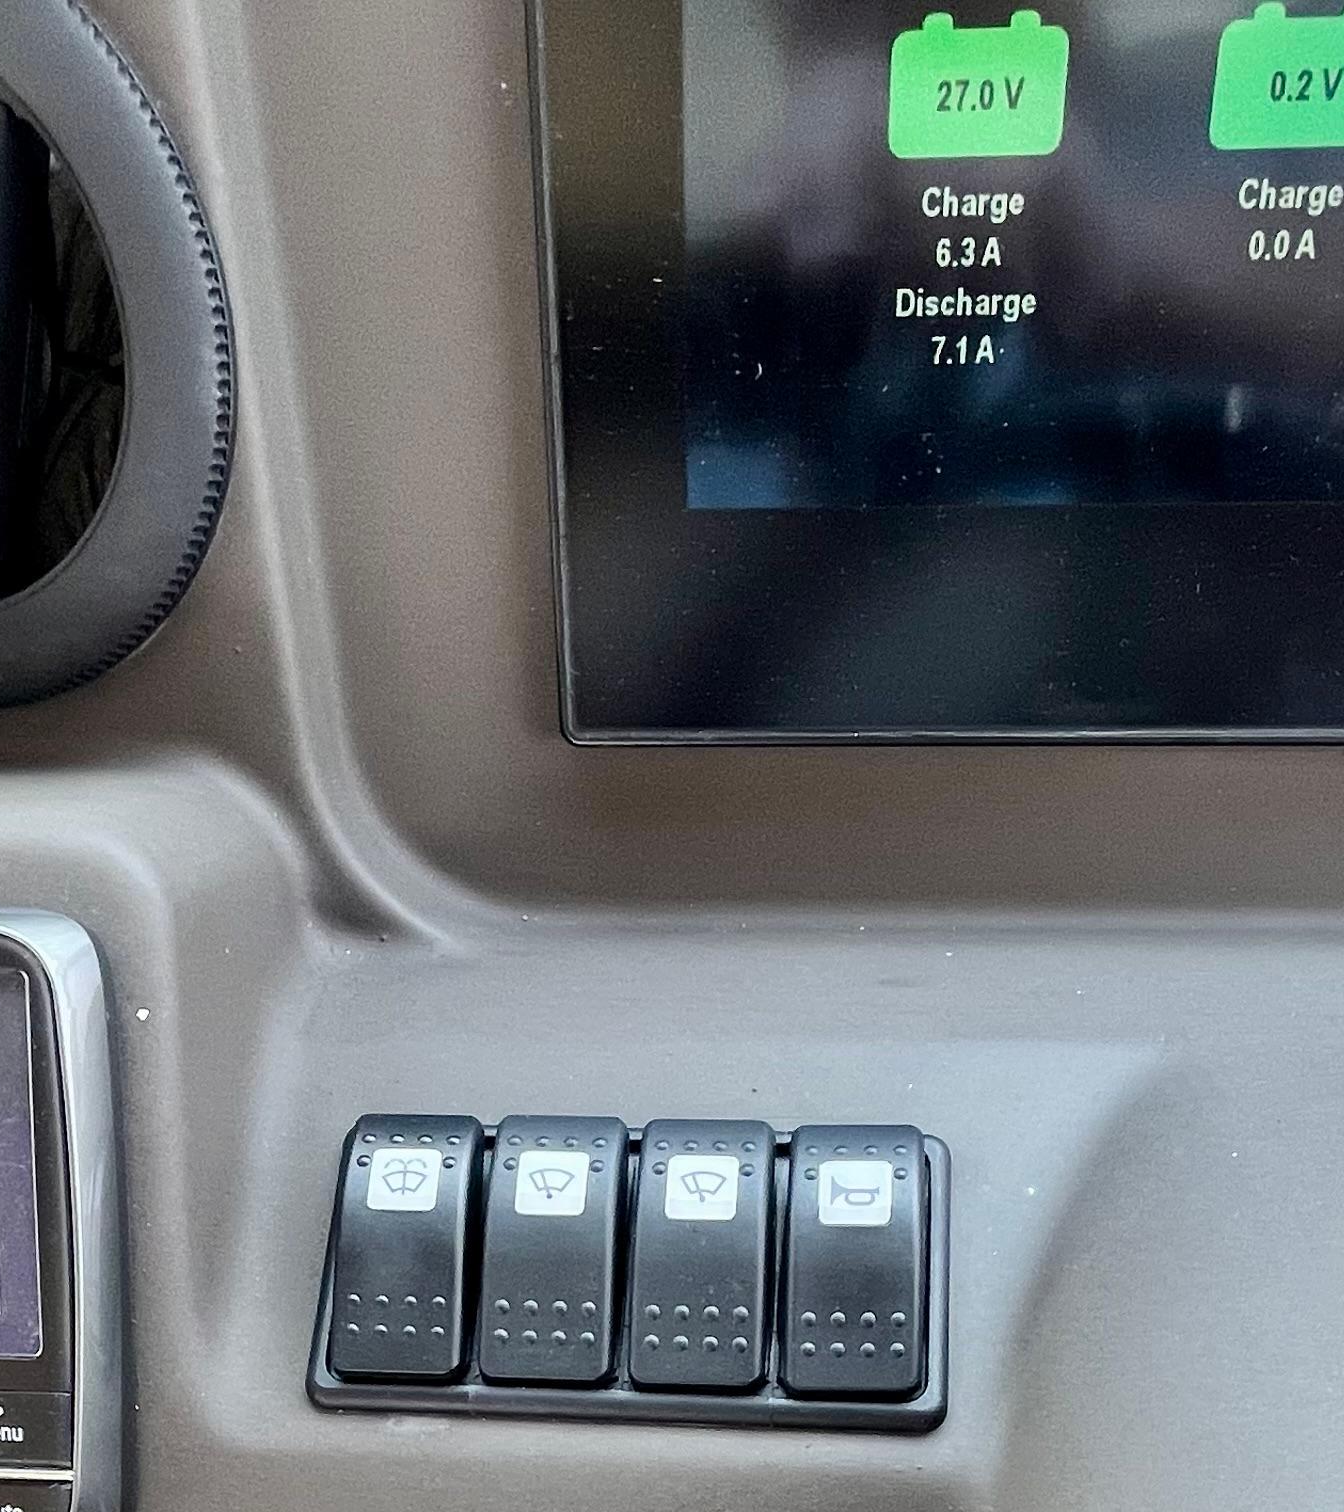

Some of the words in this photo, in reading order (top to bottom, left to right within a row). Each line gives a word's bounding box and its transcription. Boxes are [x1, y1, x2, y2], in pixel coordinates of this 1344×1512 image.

[935, 78, 995, 113] 27.0
[1003, 76, 1026, 111] V
[1269, 69, 1312, 103] 0.2
[921, 186, 1026, 225] Charge
[1238, 178, 1344, 216] Charge
[935, 236, 976, 268] 6.3
[979, 236, 1002, 268] A
[1248, 230, 1291, 262] 0.0
[1294, 229, 1316, 260] A
[894, 287, 1037, 321] Discharge
[931, 335, 969, 366] 7.1
[974, 334, 996, 365] A
